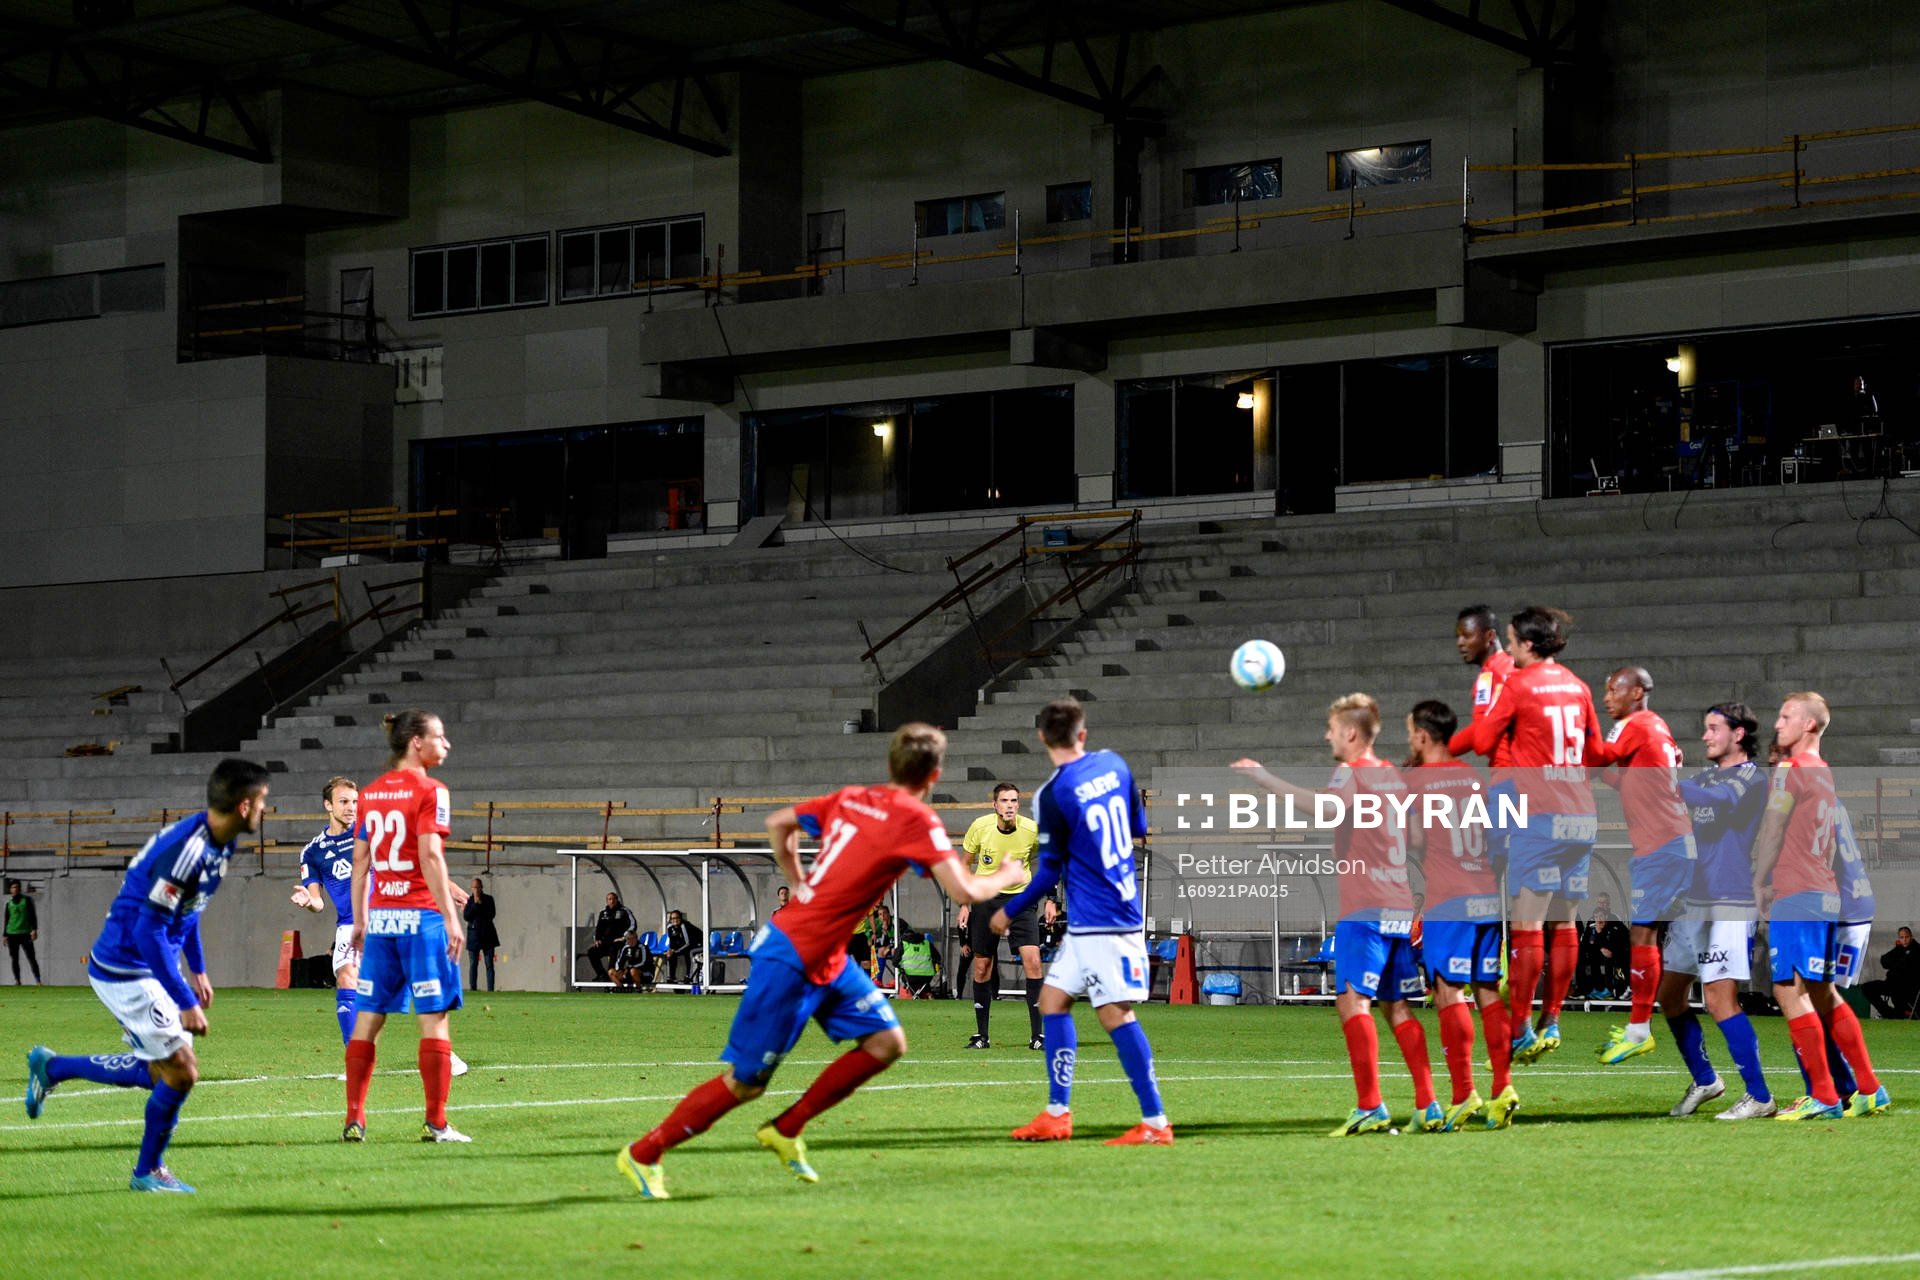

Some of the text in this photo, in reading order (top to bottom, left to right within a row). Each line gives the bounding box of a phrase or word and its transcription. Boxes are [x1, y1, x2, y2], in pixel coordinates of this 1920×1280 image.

[1543, 705, 1585, 765] 15
[365, 810, 414, 872] 22
[1086, 796, 1134, 870] 20
